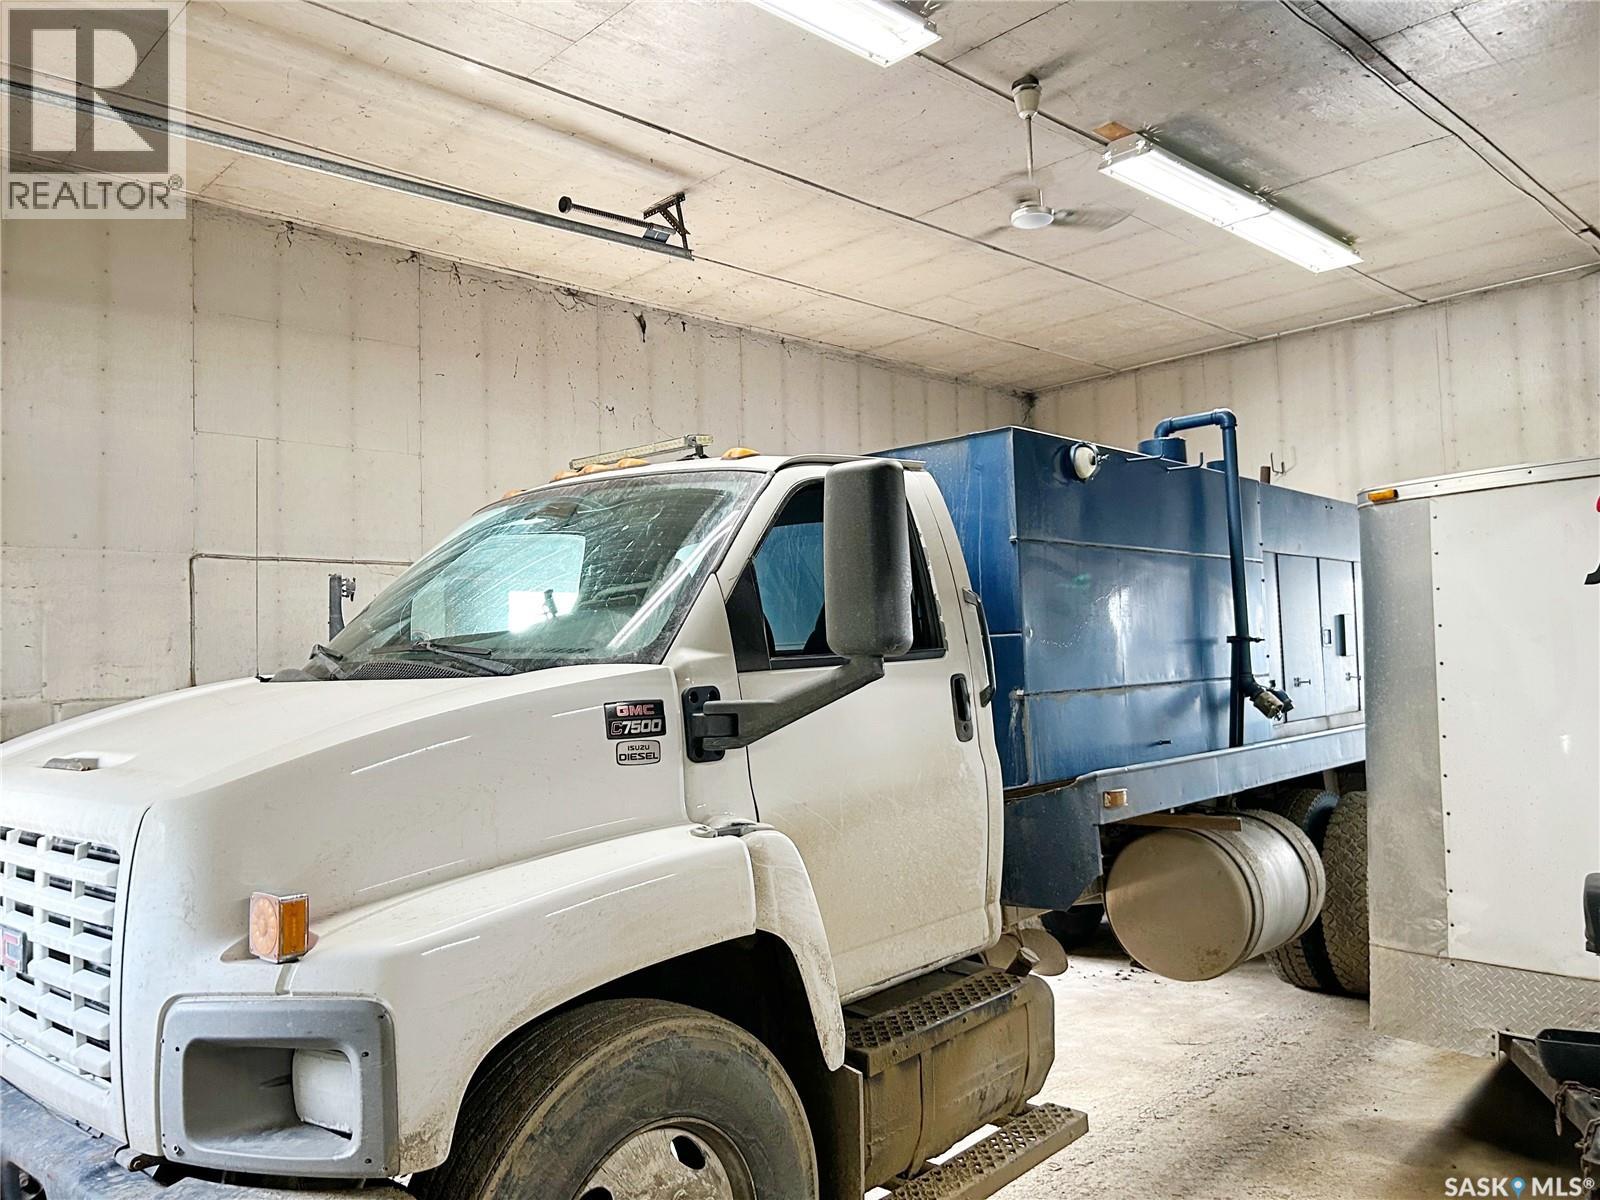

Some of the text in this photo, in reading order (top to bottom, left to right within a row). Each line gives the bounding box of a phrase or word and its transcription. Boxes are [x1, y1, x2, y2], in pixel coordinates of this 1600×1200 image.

[616, 704, 655, 717] GMC
[611, 719, 662, 735] C7500
[619, 752, 659, 761] DIESEL
